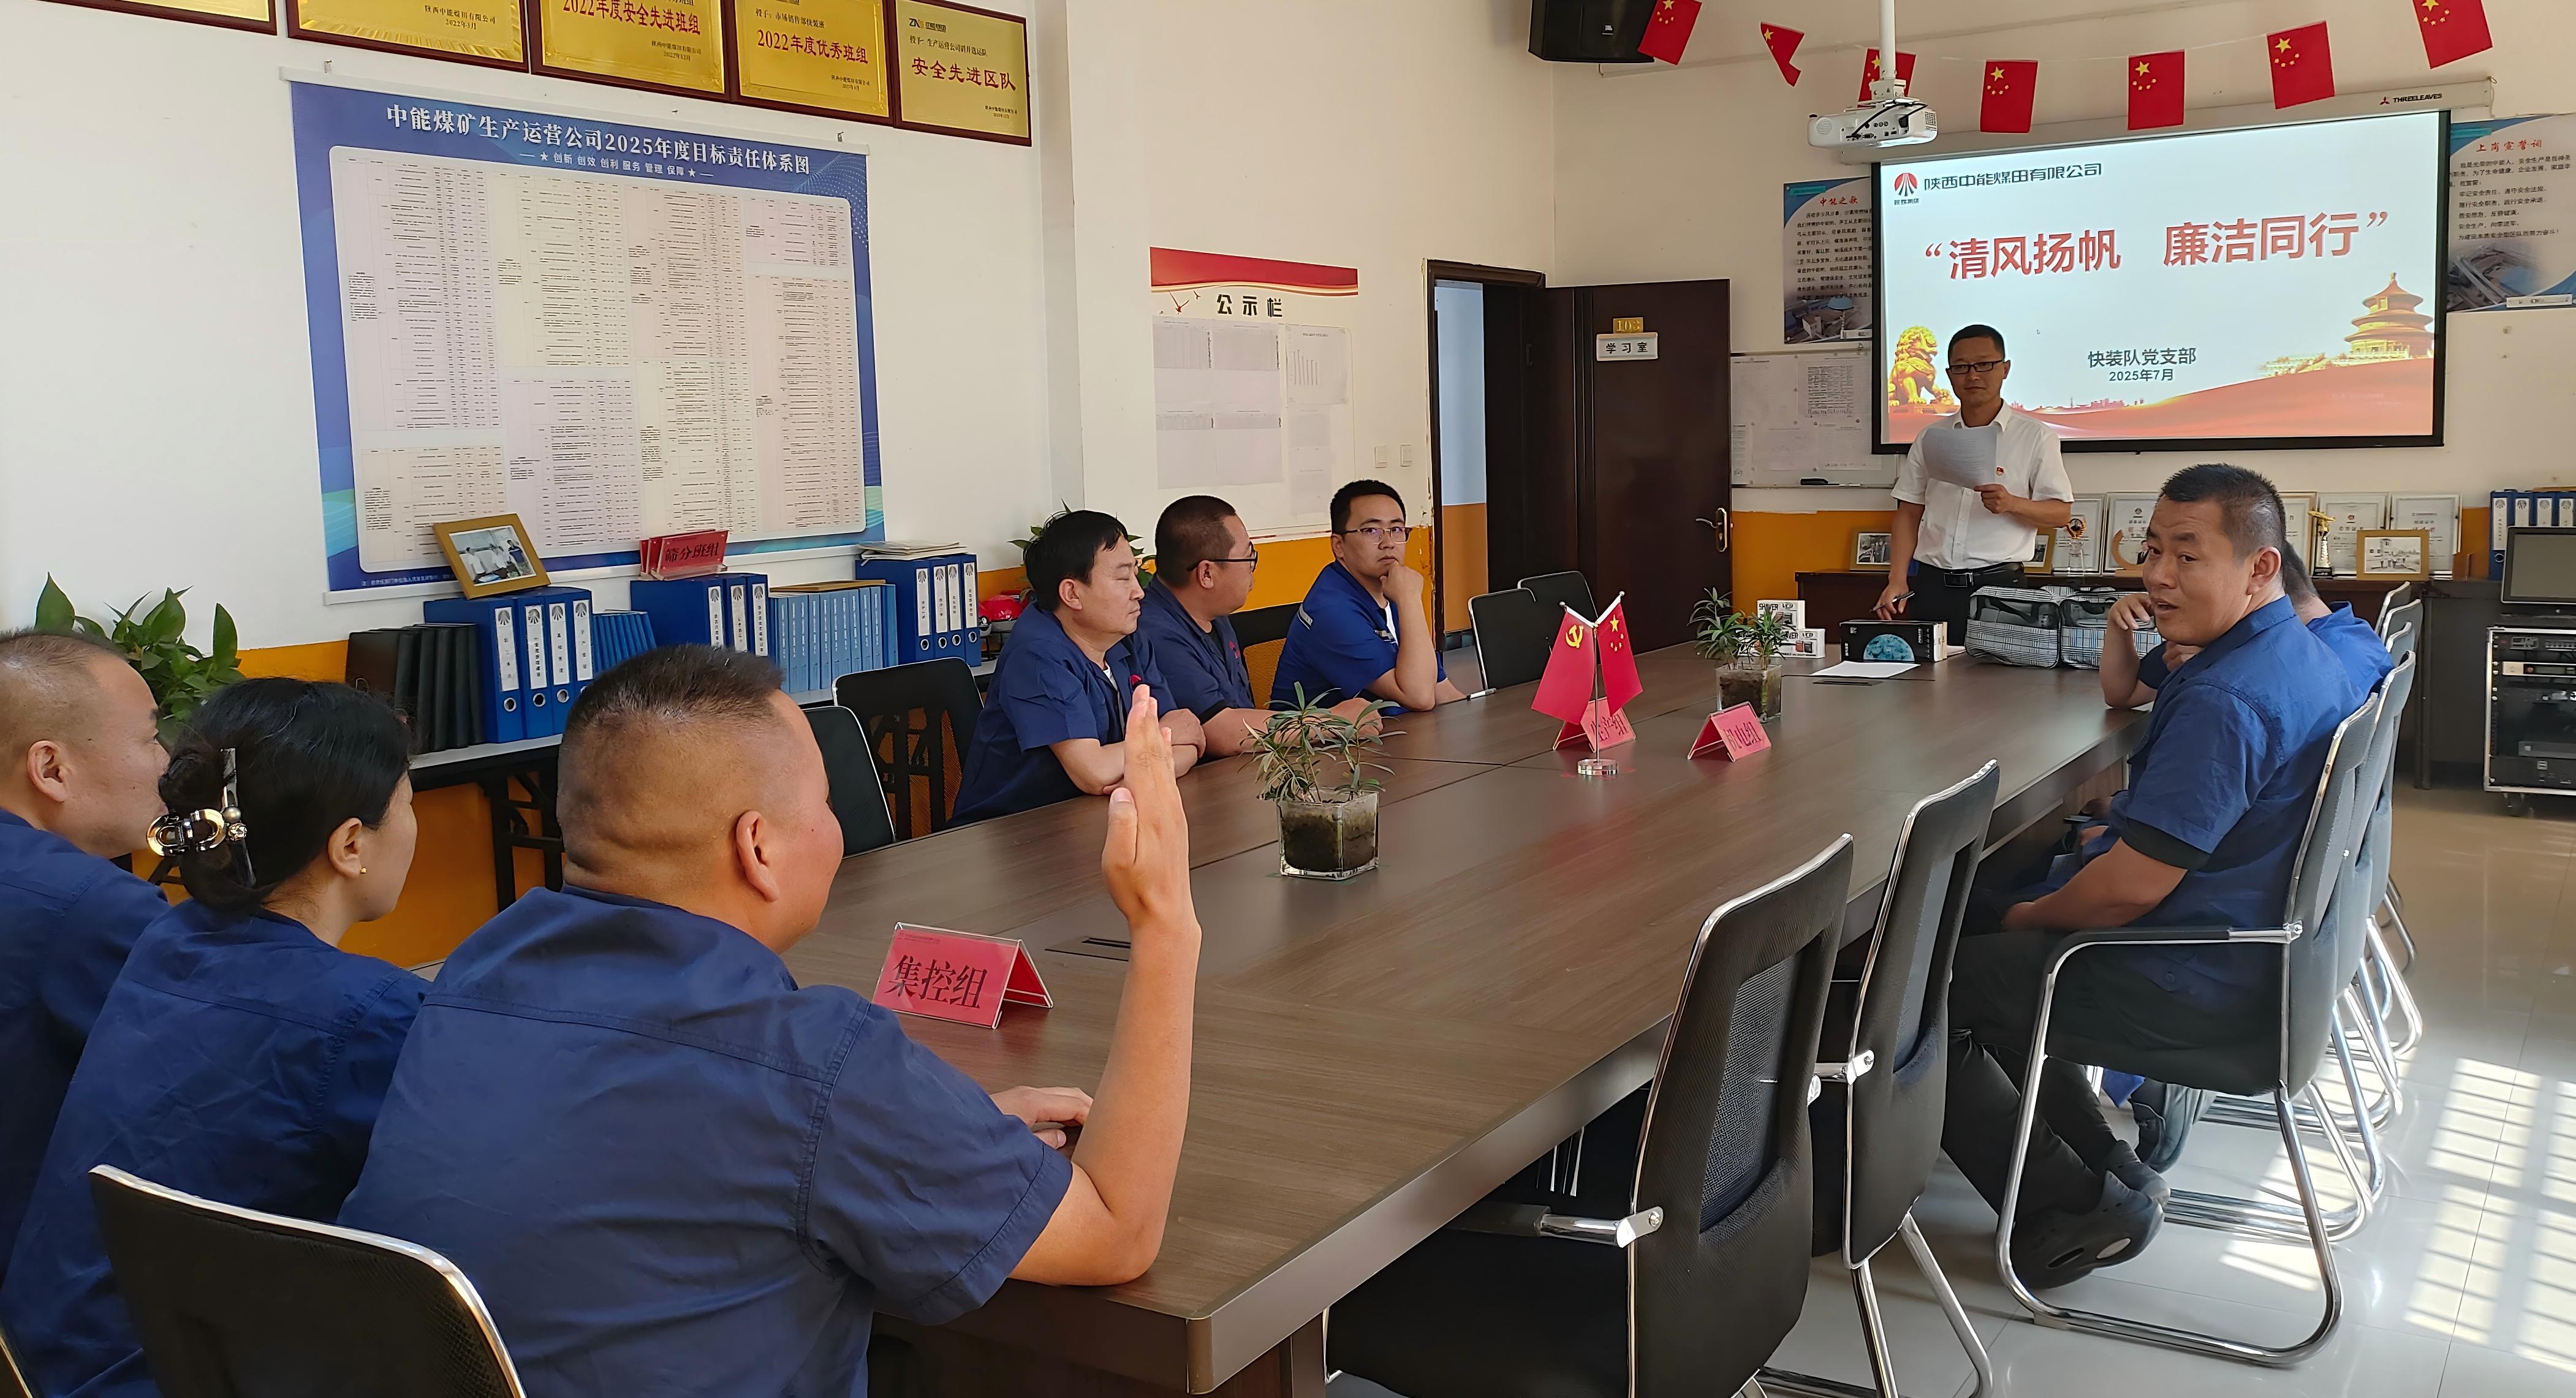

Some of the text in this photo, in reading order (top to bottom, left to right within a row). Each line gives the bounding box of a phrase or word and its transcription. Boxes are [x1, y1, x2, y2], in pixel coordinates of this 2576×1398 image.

[757, 29, 868, 64] 2022年度优秀班组
[912, 57, 1017, 91] 安全先进区队
[2393, 93, 2442, 103] THREELEAVES
[387, 104, 810, 175] 中能煤矿生产运营公司2025年度目标责任体系图
[554, 152, 685, 176] 创新 创效 创利 服务 管理 保障
[1925, 162, 2102, 191] 陕西中能煤田有限公司
[1924, 229, 2121, 281] “清风扬帆
[2162, 210, 2389, 268] 廉洁同行”
[1217, 293, 1282, 317] 公示栏
[1606, 341, 1648, 353] 学习室
[2087, 347, 2197, 369] 快装队党支部
[2108, 369, 2175, 382] 2025年7月
[665, 542, 719, 562] 筛分班组
[1723, 722, 1762, 752] 机电组
[884, 954, 988, 1008] 集控组
